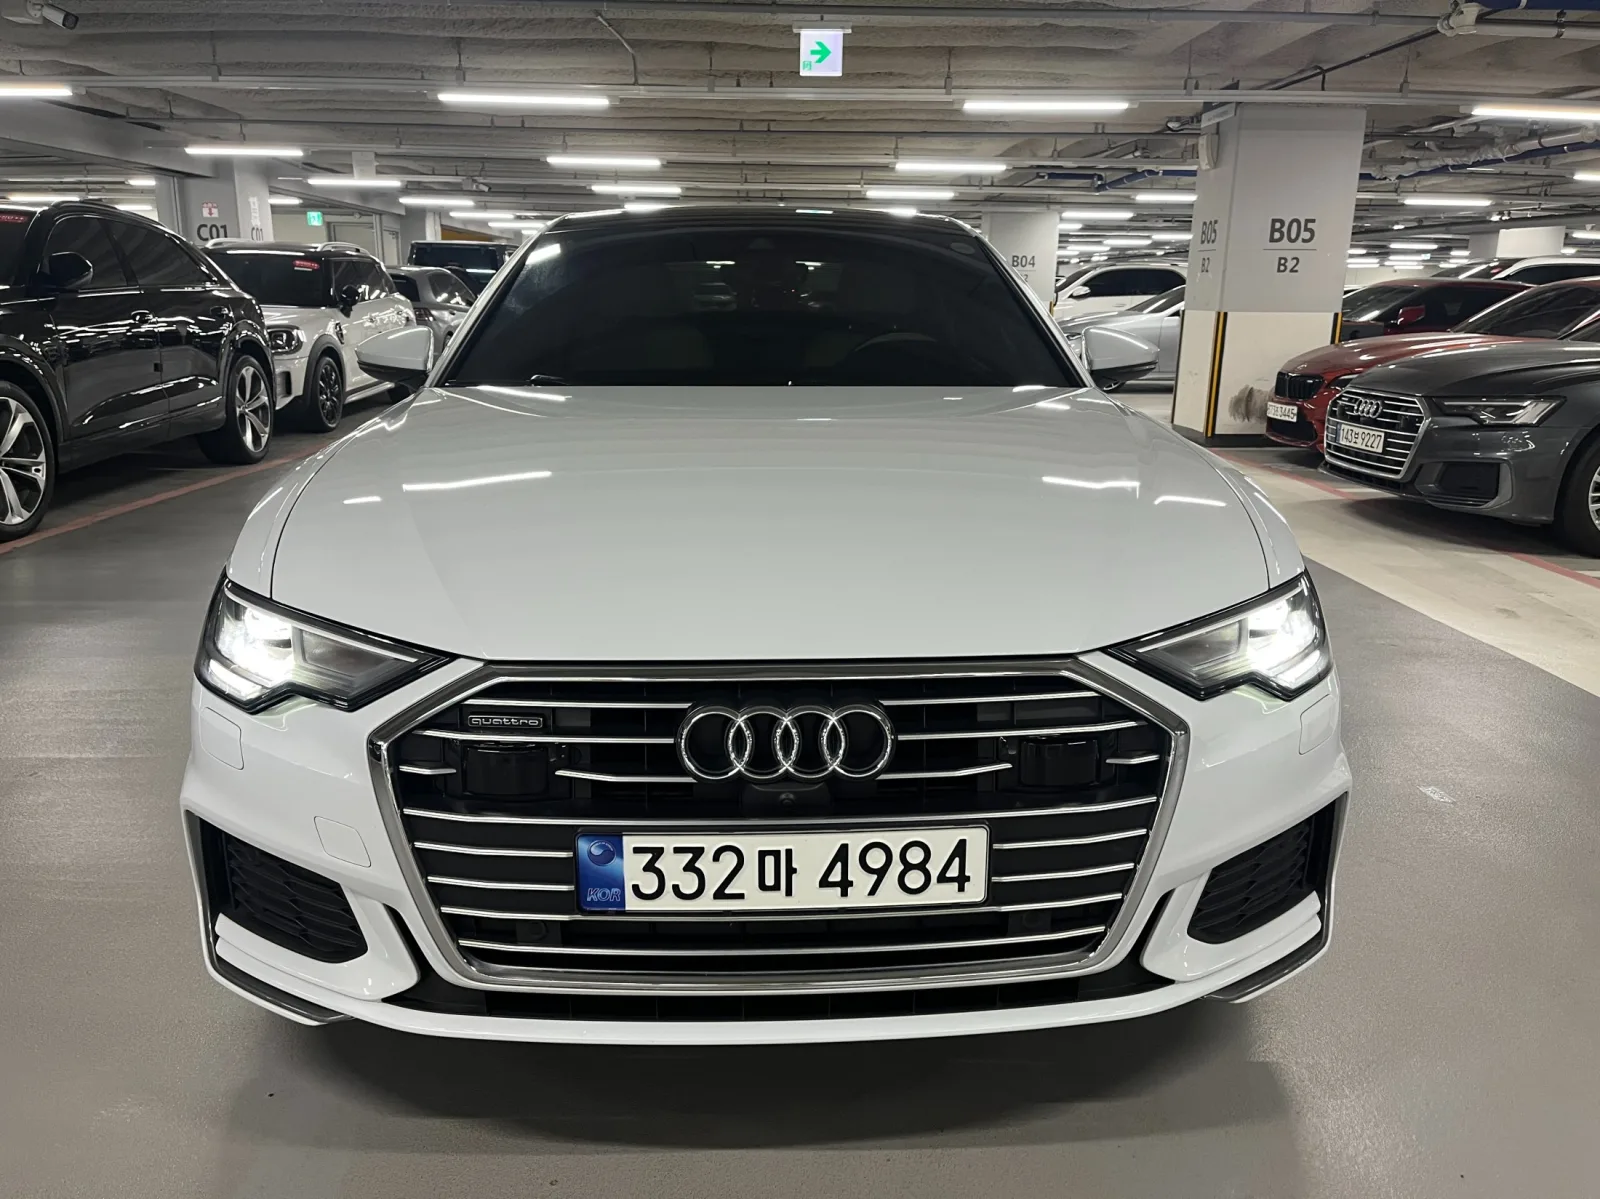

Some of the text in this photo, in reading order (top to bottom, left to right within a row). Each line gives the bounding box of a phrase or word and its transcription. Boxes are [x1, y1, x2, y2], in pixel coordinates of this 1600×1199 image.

[196, 223, 228, 241] C01
[1200, 219, 1219, 245] B05
[1268, 217, 1317, 244] B05
[1011, 254, 1036, 268] B04
[1201, 257, 1211, 273] B2
[1276, 256, 1300, 273] B2
[1360, 431, 1383, 450] 9227
[471, 717, 539, 726] quattro
[631, 838, 971, 900] 332마 4984
[586, 887, 622, 902] KOR
